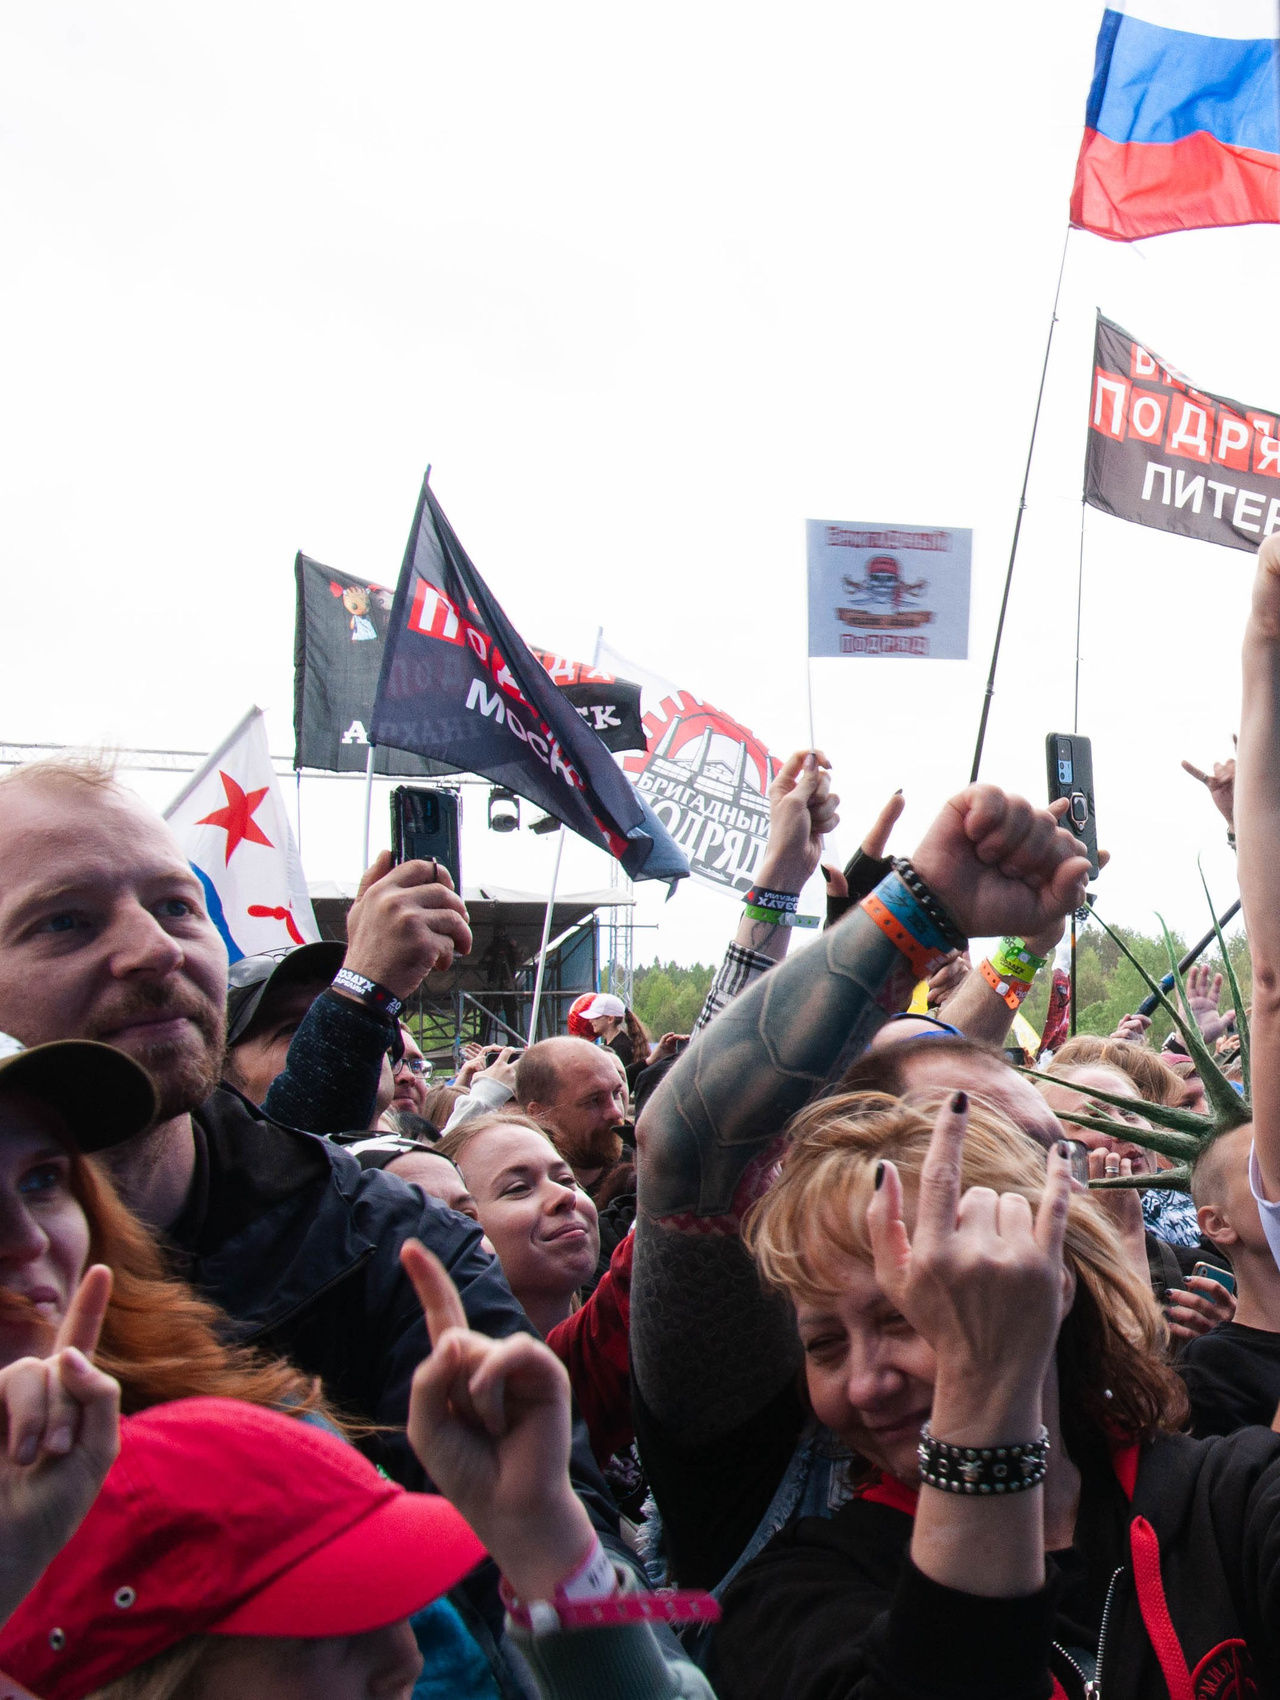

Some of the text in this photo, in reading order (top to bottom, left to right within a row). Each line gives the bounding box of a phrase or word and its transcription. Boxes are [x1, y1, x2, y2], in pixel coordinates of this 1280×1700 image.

[465, 677, 575, 786] МОСК
[636, 771, 771, 838] БРИГАДНЫЙ
[757, 896, 799, 911] ОЗДУХ
[334, 977, 366, 995] АРЕЛИИ
[339, 969, 376, 992] ОЗДУХ
[389, 997, 402, 1010] 20
